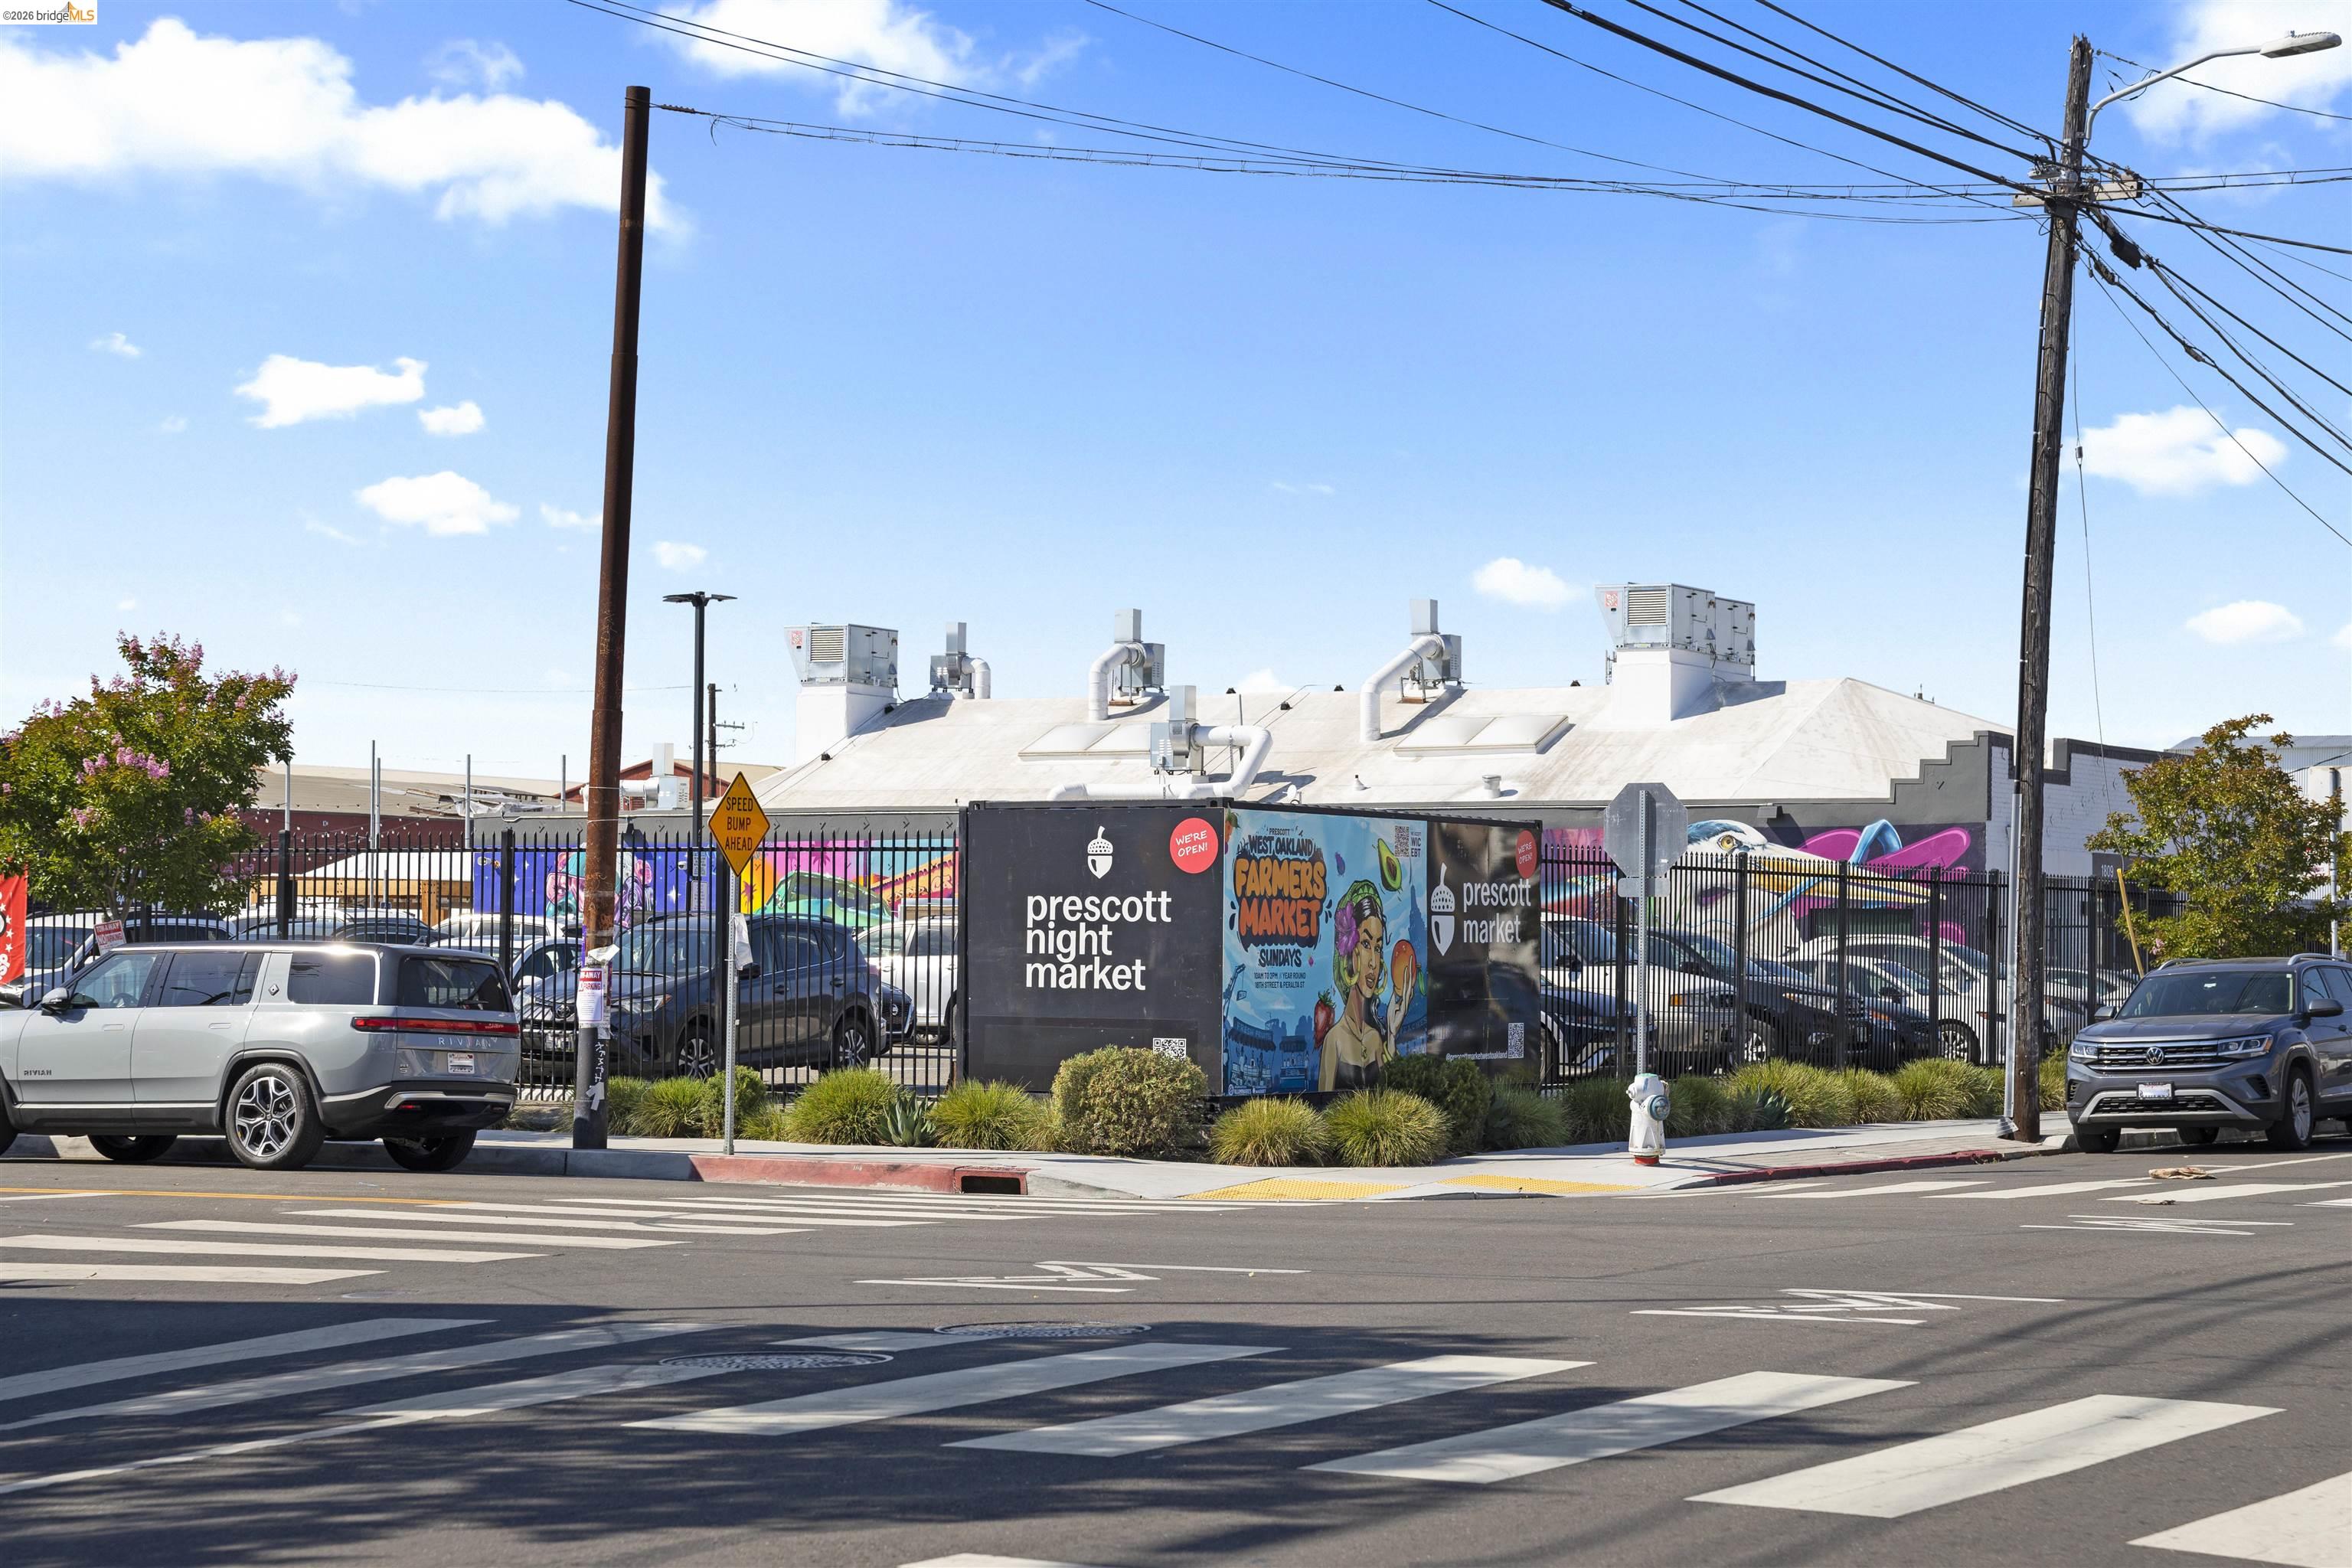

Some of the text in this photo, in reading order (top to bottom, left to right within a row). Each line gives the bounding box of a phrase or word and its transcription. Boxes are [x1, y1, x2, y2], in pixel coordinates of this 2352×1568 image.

[726, 796, 753, 812] SPEED
[727, 816, 751, 831] BUMP
[725, 836, 753, 851] AHEAD
[1175, 830, 1207, 846] WE'RE
[1248, 835, 1313, 857] WEST OAKLAND
[1410, 837, 1421, 847] WIC
[1178, 841, 1207, 858] OPEN!
[1411, 848, 1421, 858] EBT
[1235, 858, 1325, 899] FARMERS
[1463, 878, 1531, 913] prescott
[1027, 890, 1171, 928] prescott
[1240, 898, 1321, 937] MARKET
[1463, 913, 1521, 943] market
[1026, 921, 1112, 963] night
[1259, 949, 1302, 968] SUNDAYS
[1026, 956, 1146, 991] market
[438, 1037, 491, 1047] RIVIAN
